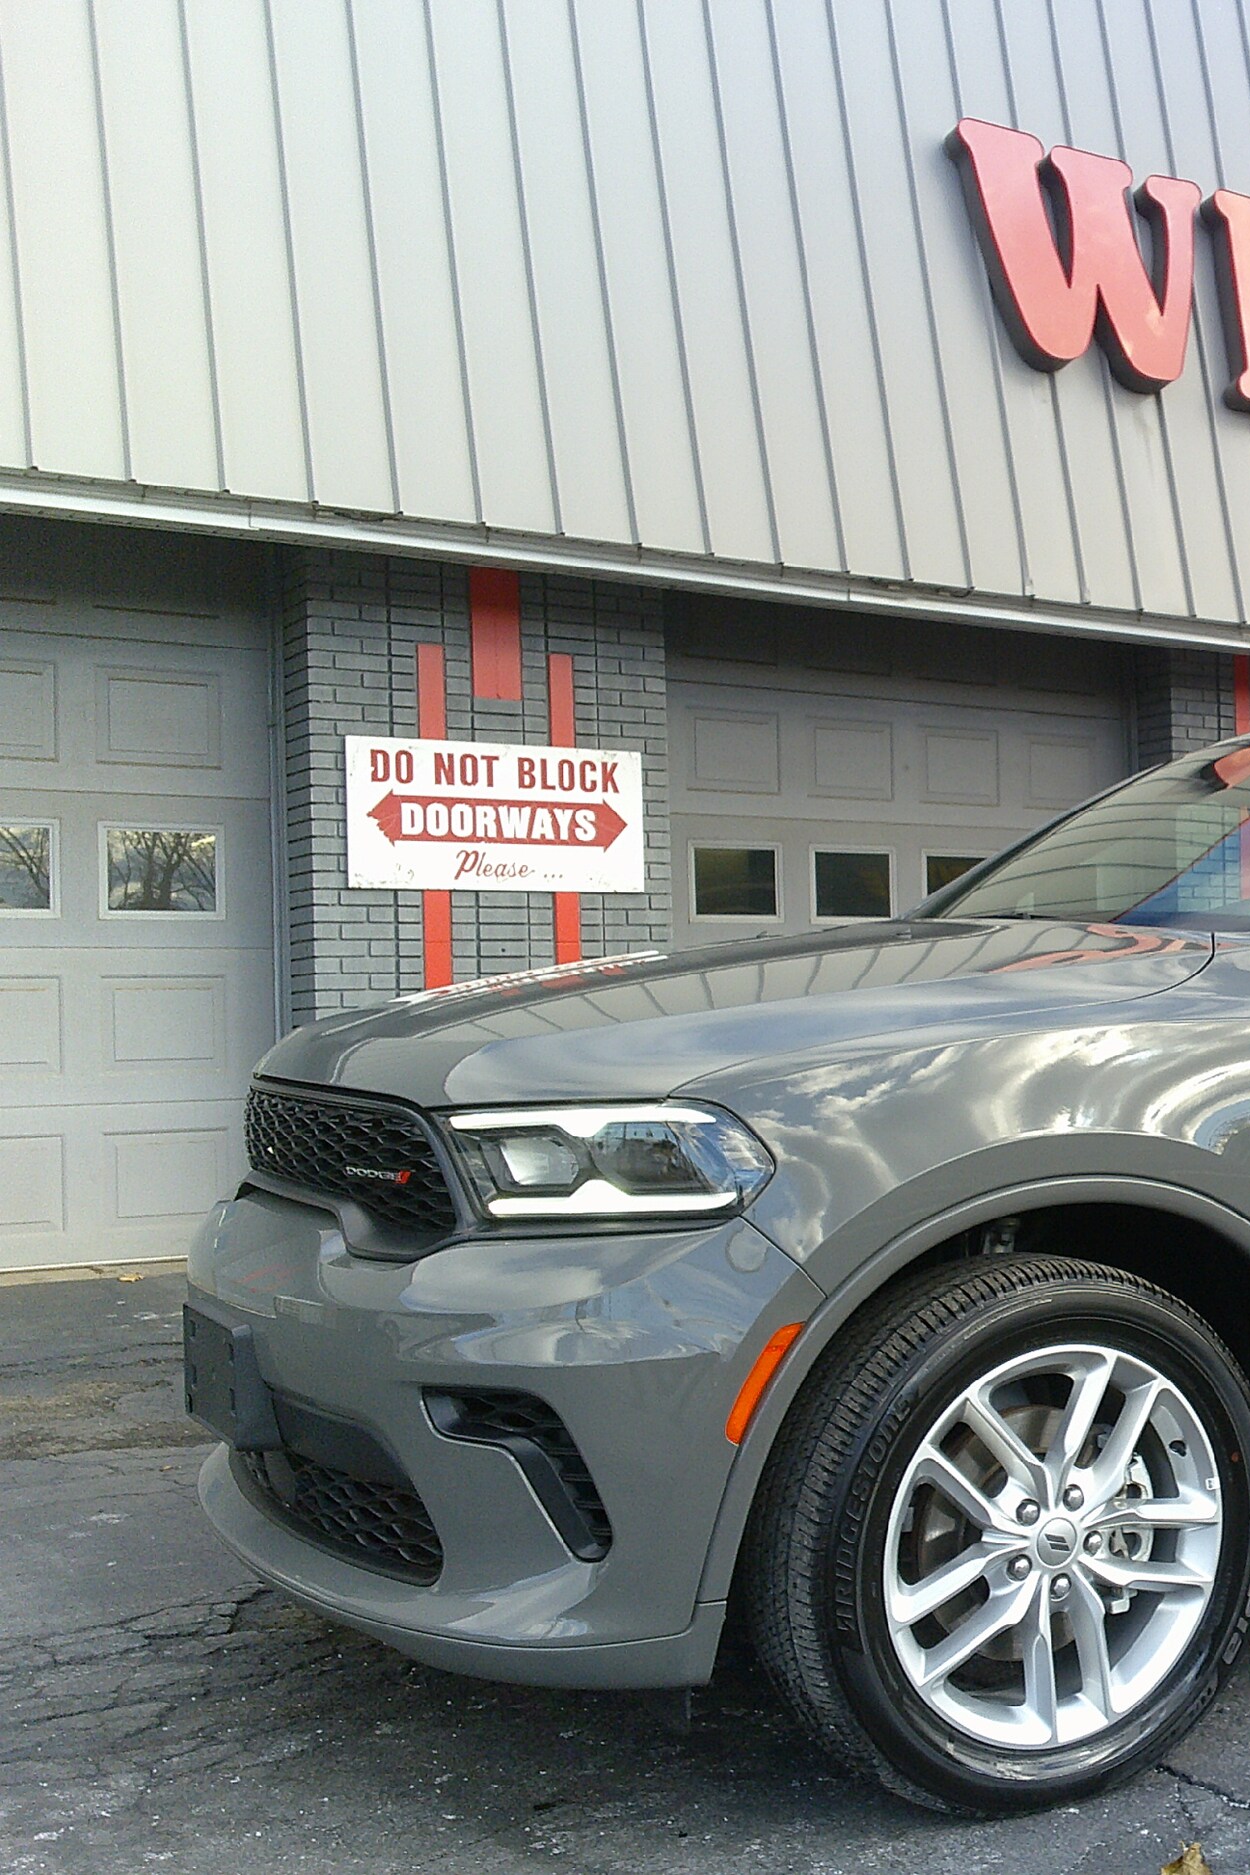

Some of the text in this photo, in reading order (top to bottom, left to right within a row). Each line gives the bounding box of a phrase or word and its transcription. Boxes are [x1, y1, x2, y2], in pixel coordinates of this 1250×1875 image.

[370, 749, 620, 793] DO NOT BLOCK
[400, 801, 597, 842] DOORWAYS
[454, 849, 535, 880] Please
[345, 1166, 403, 1182] DODGE
